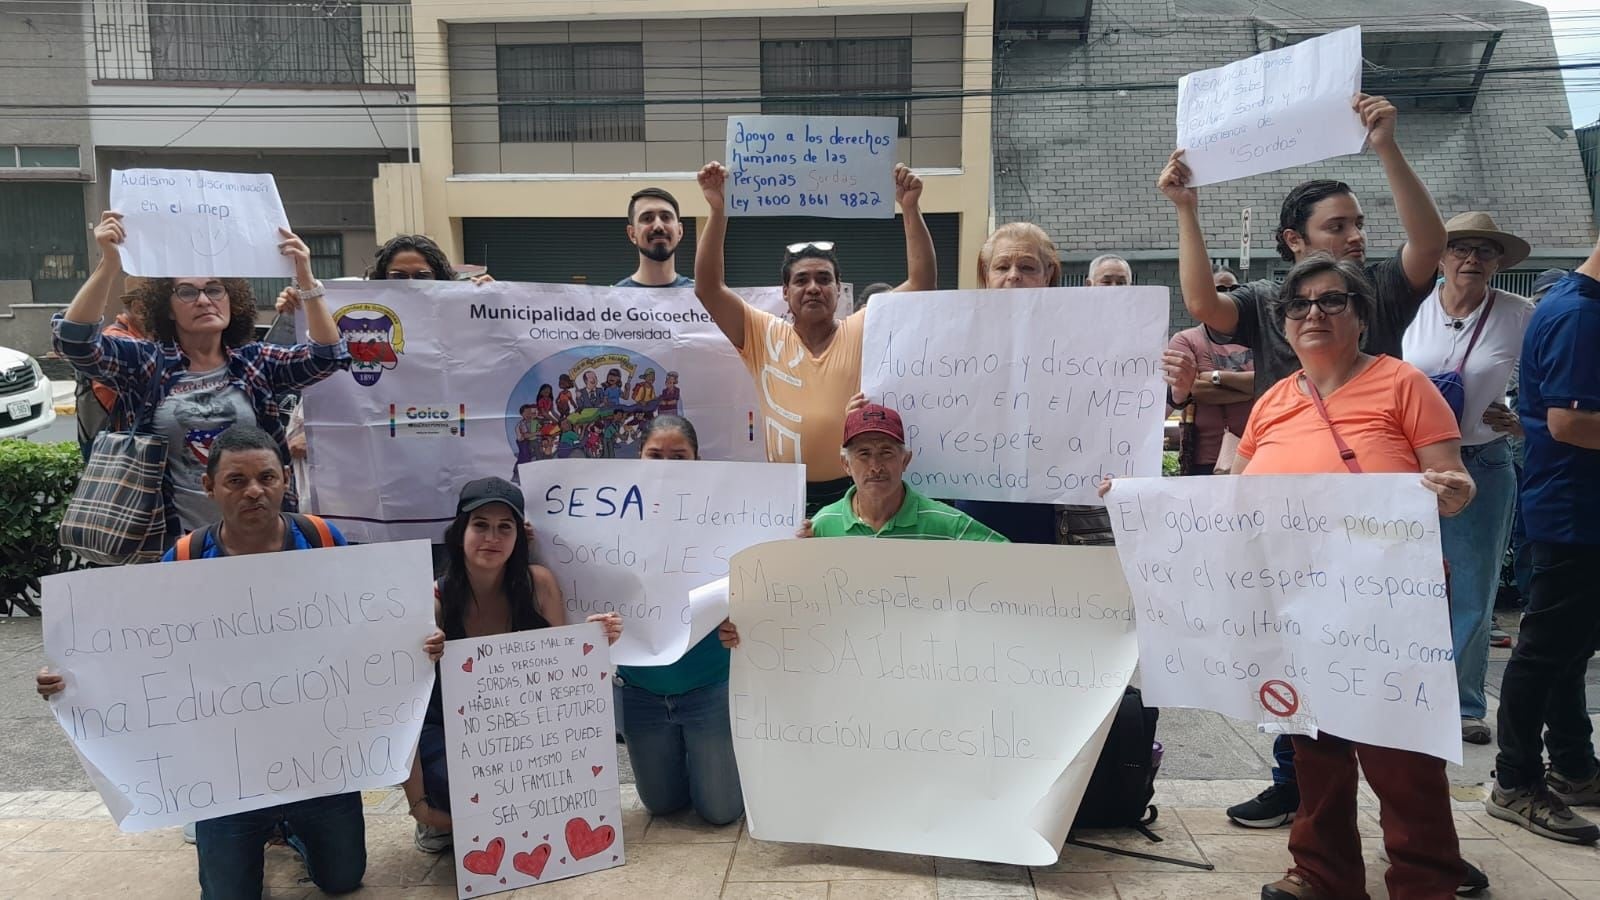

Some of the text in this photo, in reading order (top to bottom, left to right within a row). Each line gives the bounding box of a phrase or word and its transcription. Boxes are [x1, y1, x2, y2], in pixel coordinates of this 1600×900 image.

[1257, 115, 1275, 129] de
[786, 131, 795, 142] a
[806, 124, 823, 144] los
[829, 126, 890, 155] derechos
[733, 149, 847, 172] humanos de las
[121, 173, 176, 187] Audismo
[733, 169, 857, 192] Personas Sordas
[141, 200, 159, 212] en
[170, 203, 182, 214] el
[757, 194, 791, 206] 7600
[800, 193, 828, 206] 8661
[840, 191, 881, 207] 9822
[470, 304, 596, 324] Municipalidad
[601, 308, 621, 322] de
[529, 327, 671, 341] Oficina de Diversidad
[876, 329, 999, 379] Audismo
[359, 373, 375, 382] 1891
[406, 407, 449, 420] Goico
[881, 388, 969, 411] nación
[1088, 389, 1155, 419] MEP
[939, 425, 1044, 462] respete
[1068, 435, 1083, 454] a
[1109, 427, 1131, 456] la
[910, 464, 1029, 489] omunidad
[545, 484, 644, 520] SESA
[673, 493, 795, 529] Identidad
[1118, 493, 1148, 532] El
[1165, 498, 1265, 554] gobierno
[1281, 498, 1331, 534] debe
[552, 534, 647, 573] Sorda,
[932, 596, 945, 611] a
[946, 576, 968, 613] la
[967, 581, 1081, 620] Comunidad
[1137, 561, 1173, 583] ver
[1193, 559, 1214, 592] el
[1225, 563, 1327, 599] respeto
[1354, 573, 1448, 608] espacios
[566, 580, 662, 620] ducación
[65, 583, 112, 656] La
[359, 587, 405, 623] es
[1146, 596, 1169, 626] de
[1181, 600, 1207, 632] la
[1222, 609, 1301, 638] cultura
[476, 636, 576, 661] NO HABLES MAL DE
[745, 618, 864, 677] SESA
[363, 649, 415, 687] en
[477, 664, 588, 693] SORDAS, NO NO NO
[488, 656, 559, 675] LAS PERSONAS
[1165, 647, 1185, 674] el
[1203, 655, 1260, 680] caso
[1284, 659, 1312, 686] de
[519, 690, 542, 705] CON
[464, 698, 606, 735] NO SABES EL FUTURO
[460, 726, 604, 760] A USTEDES LES PUEDE
[882, 708, 1035, 760] accesible
[471, 747, 587, 779] PASAR LO MISMO EN
[494, 778, 514, 796] SU
[492, 789, 598, 826] SEA SOLIDARIO
